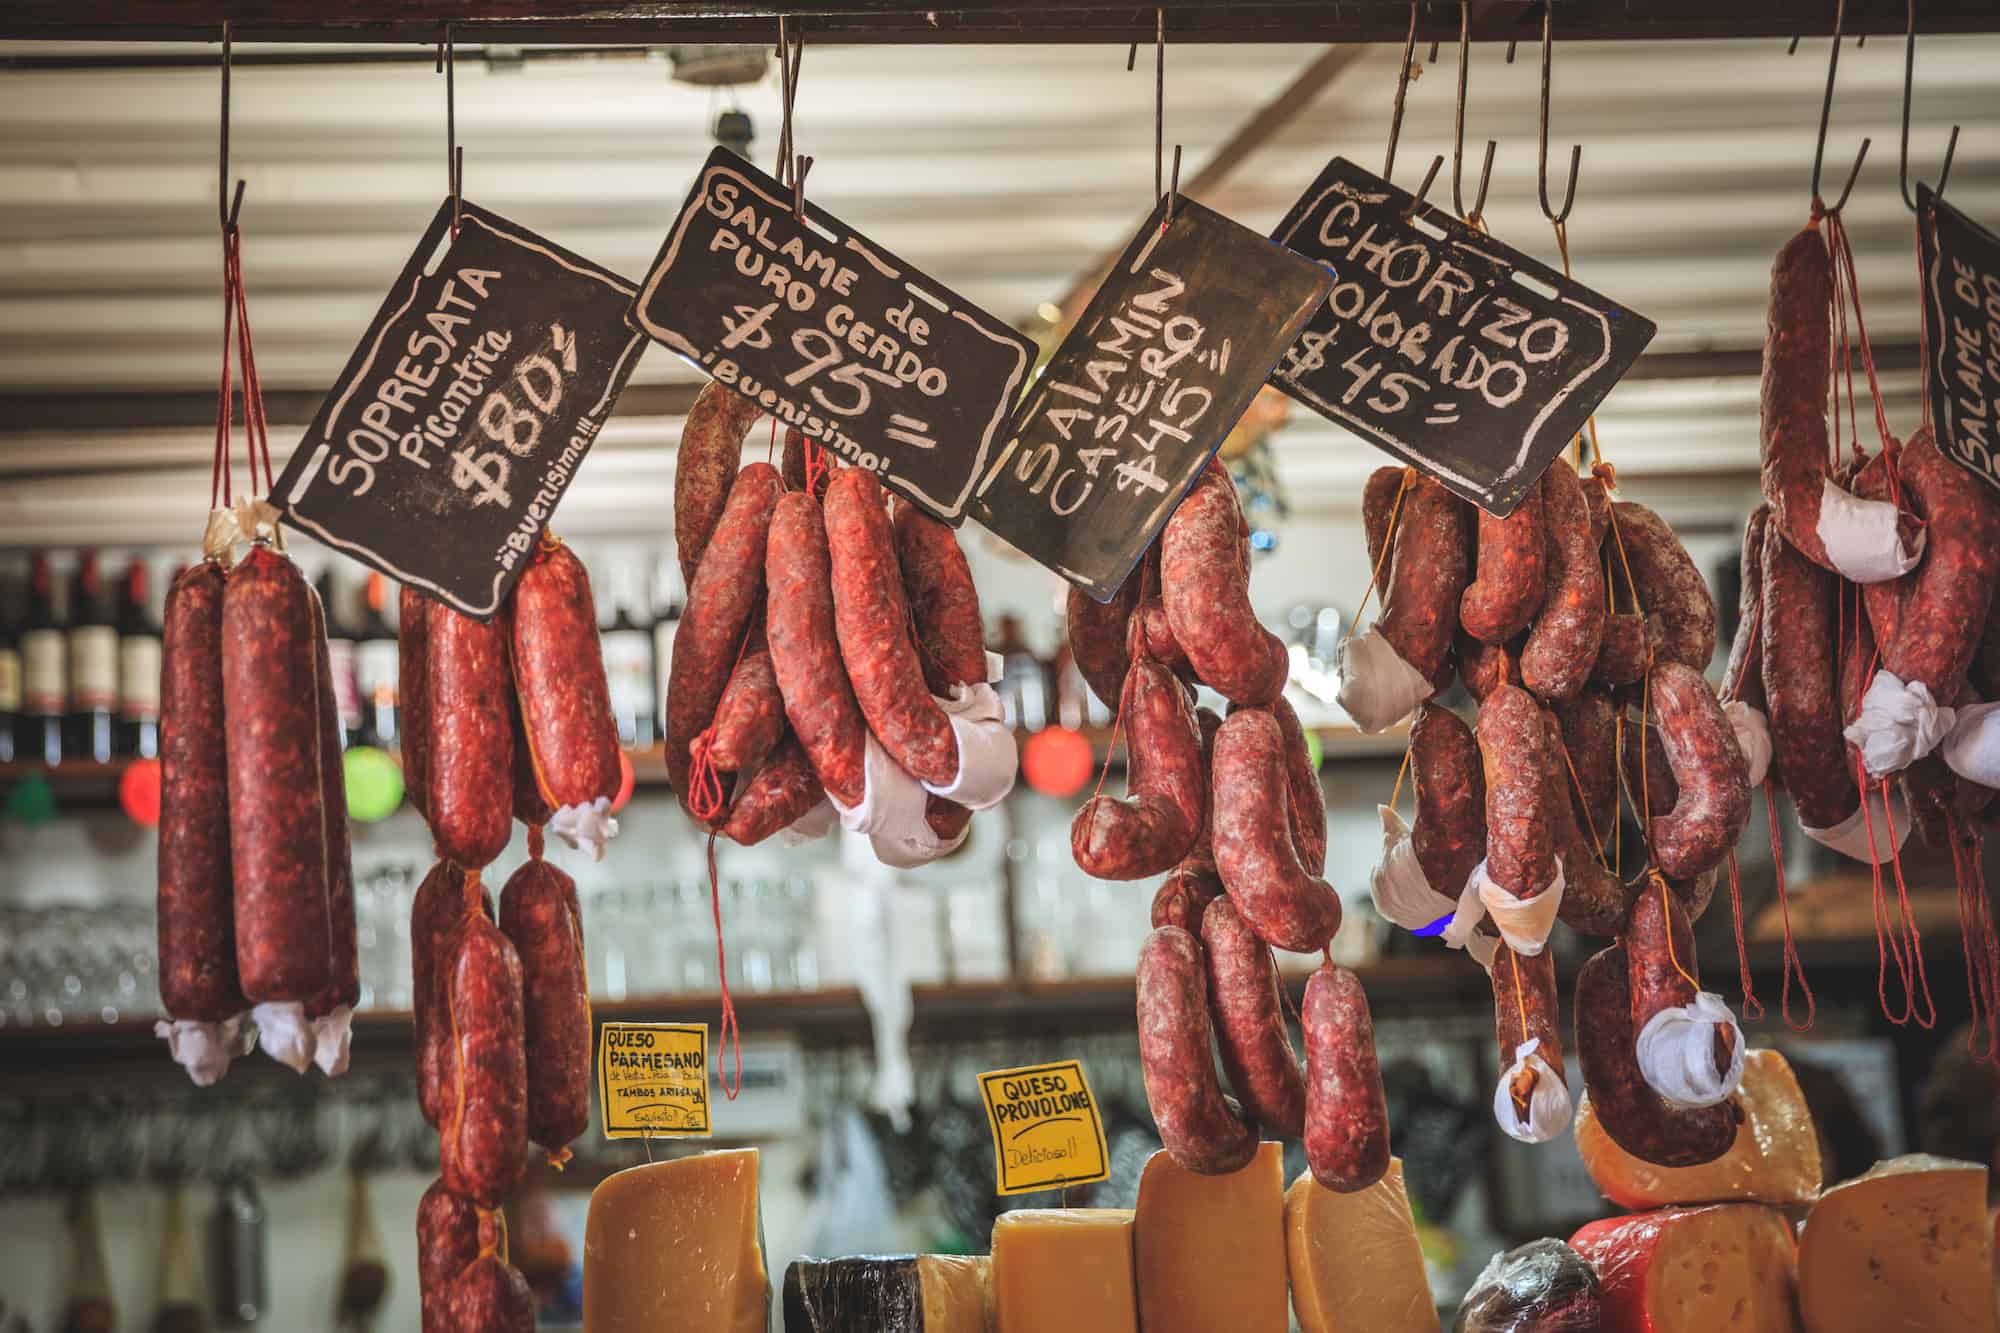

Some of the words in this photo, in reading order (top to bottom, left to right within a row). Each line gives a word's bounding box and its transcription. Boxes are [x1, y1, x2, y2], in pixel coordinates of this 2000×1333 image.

[704, 183, 859, 297] SALAME
[885, 299, 931, 347] de
[709, 229, 816, 312] PURO
[825, 304, 948, 397] CERDO
[1953, 256, 1980, 309] DE
[327, 268, 502, 497] SOPRESATA
[399, 329, 513, 469] Picantita
[1051, 315, 1205, 516] CASERO
[1953, 315, 1992, 475] SALAME
[608, 1032, 655, 1050] QUESO
[610, 1051, 703, 1071] PARMESANO
[996, 1090, 1090, 1124] PROVOLONE
[1003, 1075, 1067, 1101] QUESO
